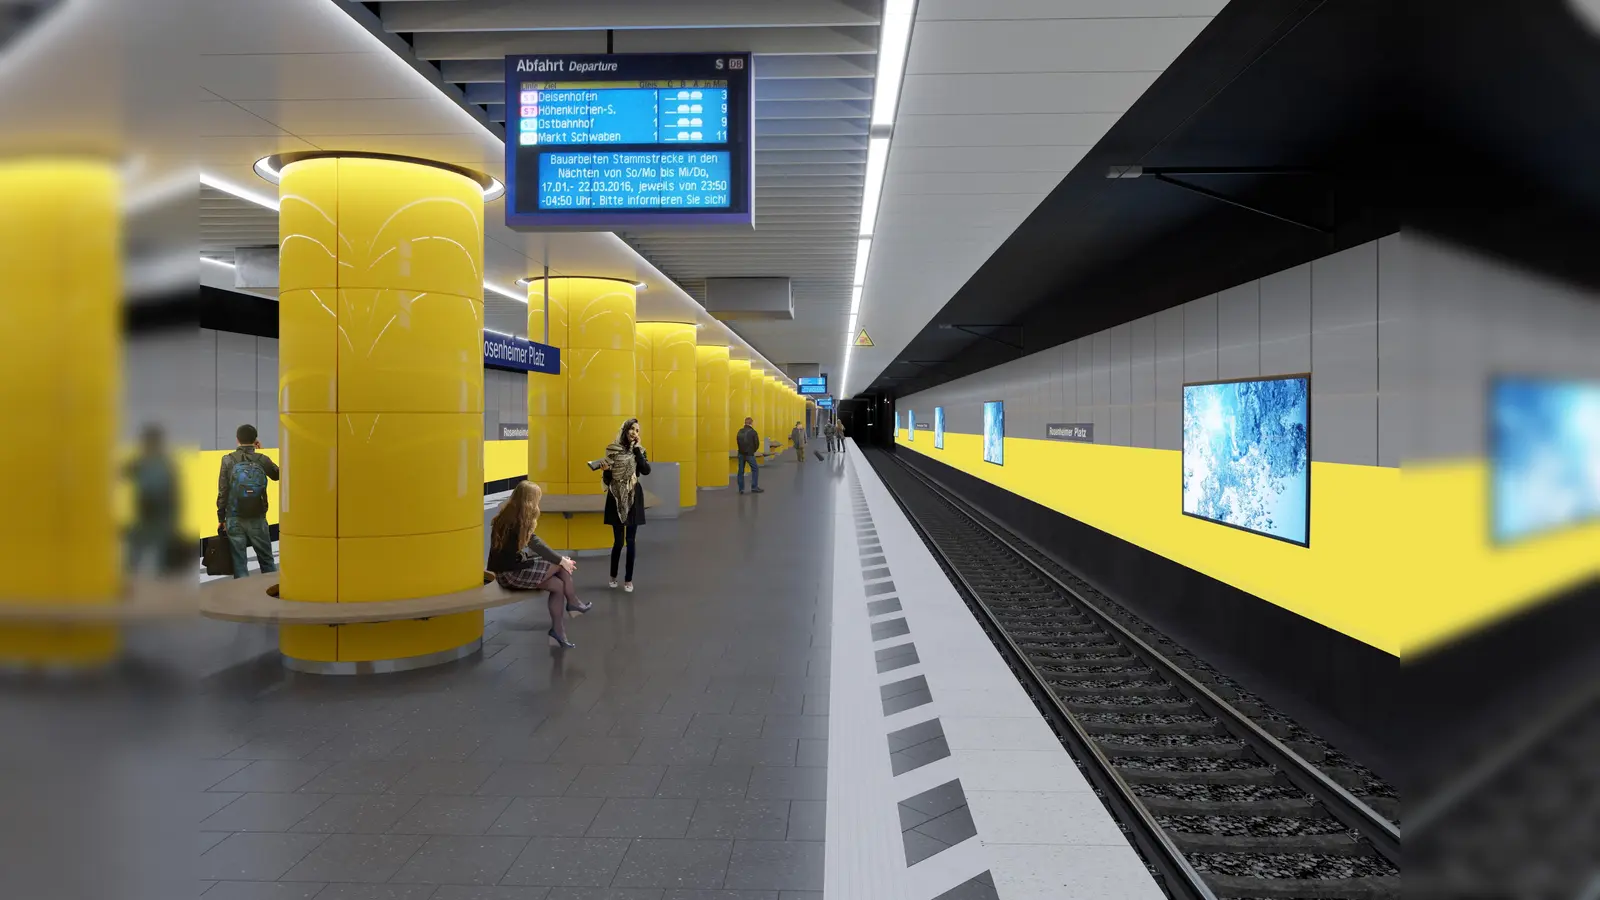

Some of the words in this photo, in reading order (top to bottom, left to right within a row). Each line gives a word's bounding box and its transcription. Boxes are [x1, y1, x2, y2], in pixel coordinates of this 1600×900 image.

[516, 59, 564, 72] Abfahrt
[569, 61, 618, 73] Departure
[715, 59, 724, 69] S
[730, 59, 743, 69] DB
[538, 92, 598, 102] Deisenhofen
[653, 90, 658, 101] 1
[721, 90, 728, 100] 3
[538, 104, 616, 115] Höhenkirchen-S.
[653, 104, 658, 114] 1
[721, 103, 728, 114] 9
[538, 118, 595, 129] Ostbahnhof
[653, 117, 658, 128] 1
[721, 117, 728, 127] 9
[538, 131, 567, 142] Markt
[571, 132, 621, 142] Schwaben
[653, 131, 658, 141] 1
[716, 130, 728, 141] 11
[550, 154, 609, 165] Bauarbeiten
[613, 153, 684, 164] Stammstrecke
[688, 153, 696, 164] in
[700, 153, 718, 164] den
[558, 168, 600, 178] Nächten
[603, 169, 622, 178] von
[625, 167, 657, 178] So/Mo
[660, 167, 675, 178] bis
[678, 166, 709, 178] Mi/Do,
[541, 182, 574, 192] 17.01.-
[578, 181, 634, 193] 22.03.2016,
[638, 181, 675, 194] jeweils
[679, 182, 697, 191] von
[701, 180, 727, 191] 23:50
[541, 195, 572, 206] -04:50
[576, 195, 596, 206] Uhr.
[599, 195, 624, 206] Bitte
[627, 195, 683, 205] informieren
[686, 194, 701, 205] Sie
[483, 340, 528, 363] osenheimer
[529, 345, 545, 366] Platz
[1074, 427, 1087, 438] Platz
